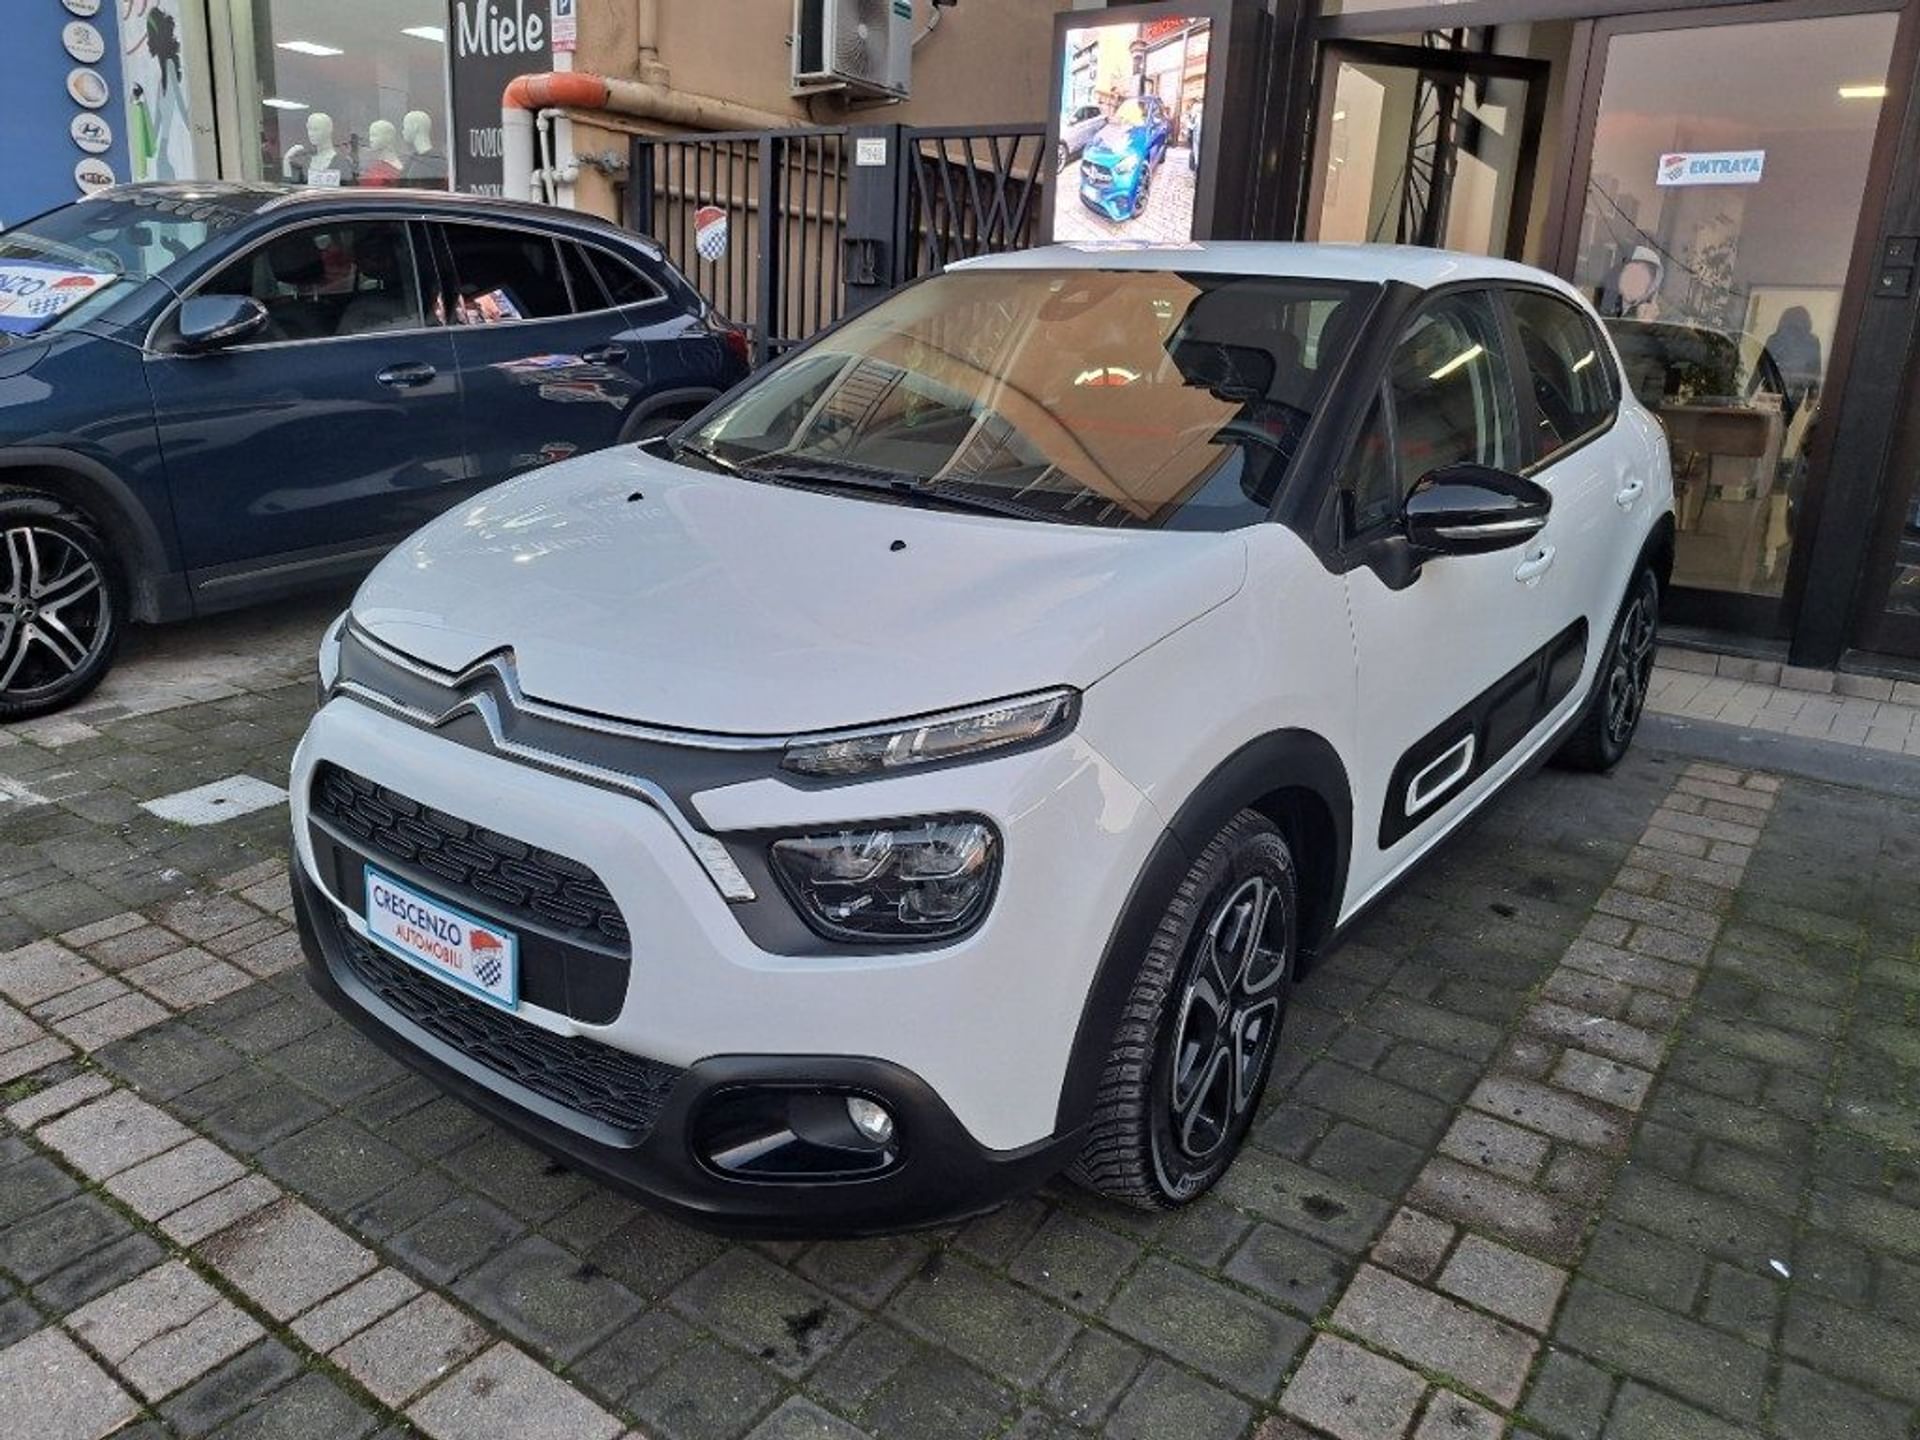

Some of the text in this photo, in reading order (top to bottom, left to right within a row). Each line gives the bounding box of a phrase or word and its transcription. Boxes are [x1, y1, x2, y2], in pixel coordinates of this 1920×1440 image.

[457, 0, 544, 57] Miele
[1690, 158, 1760, 174] ENTRATA
[373, 885, 462, 946] CRESCENZO
[396, 925, 462, 969] AUTOMOBILI
